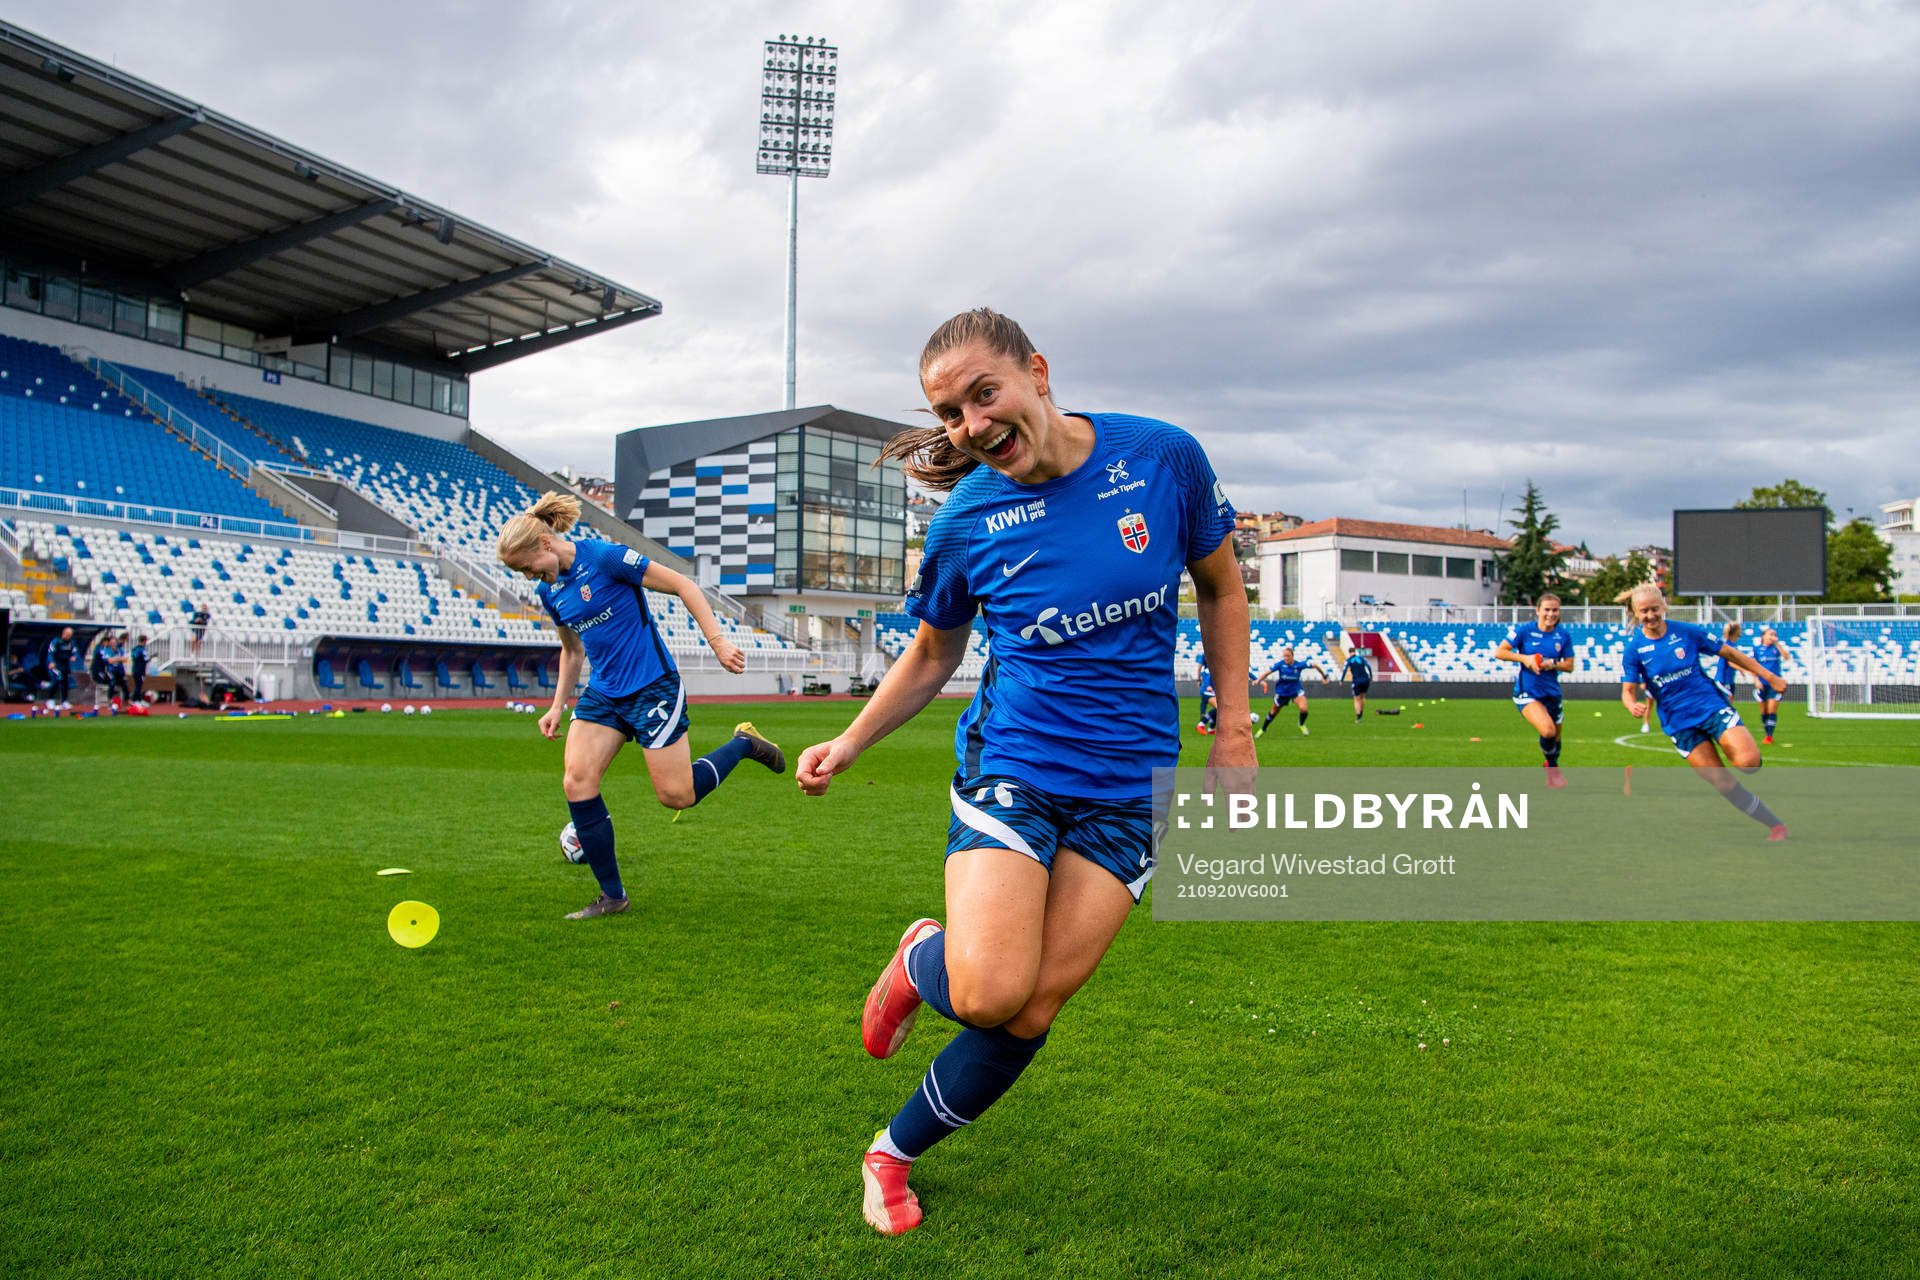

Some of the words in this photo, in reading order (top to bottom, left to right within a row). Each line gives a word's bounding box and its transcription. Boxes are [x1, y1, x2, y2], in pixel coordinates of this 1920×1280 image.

[1097, 487, 1120, 501] Norsk
[1118, 479, 1146, 493] Tipping
[1027, 498, 1046, 512] mini
[1029, 509, 1046, 522] pris
[985, 505, 1028, 534] KIWI
[1060, 584, 1168, 637] telenor
